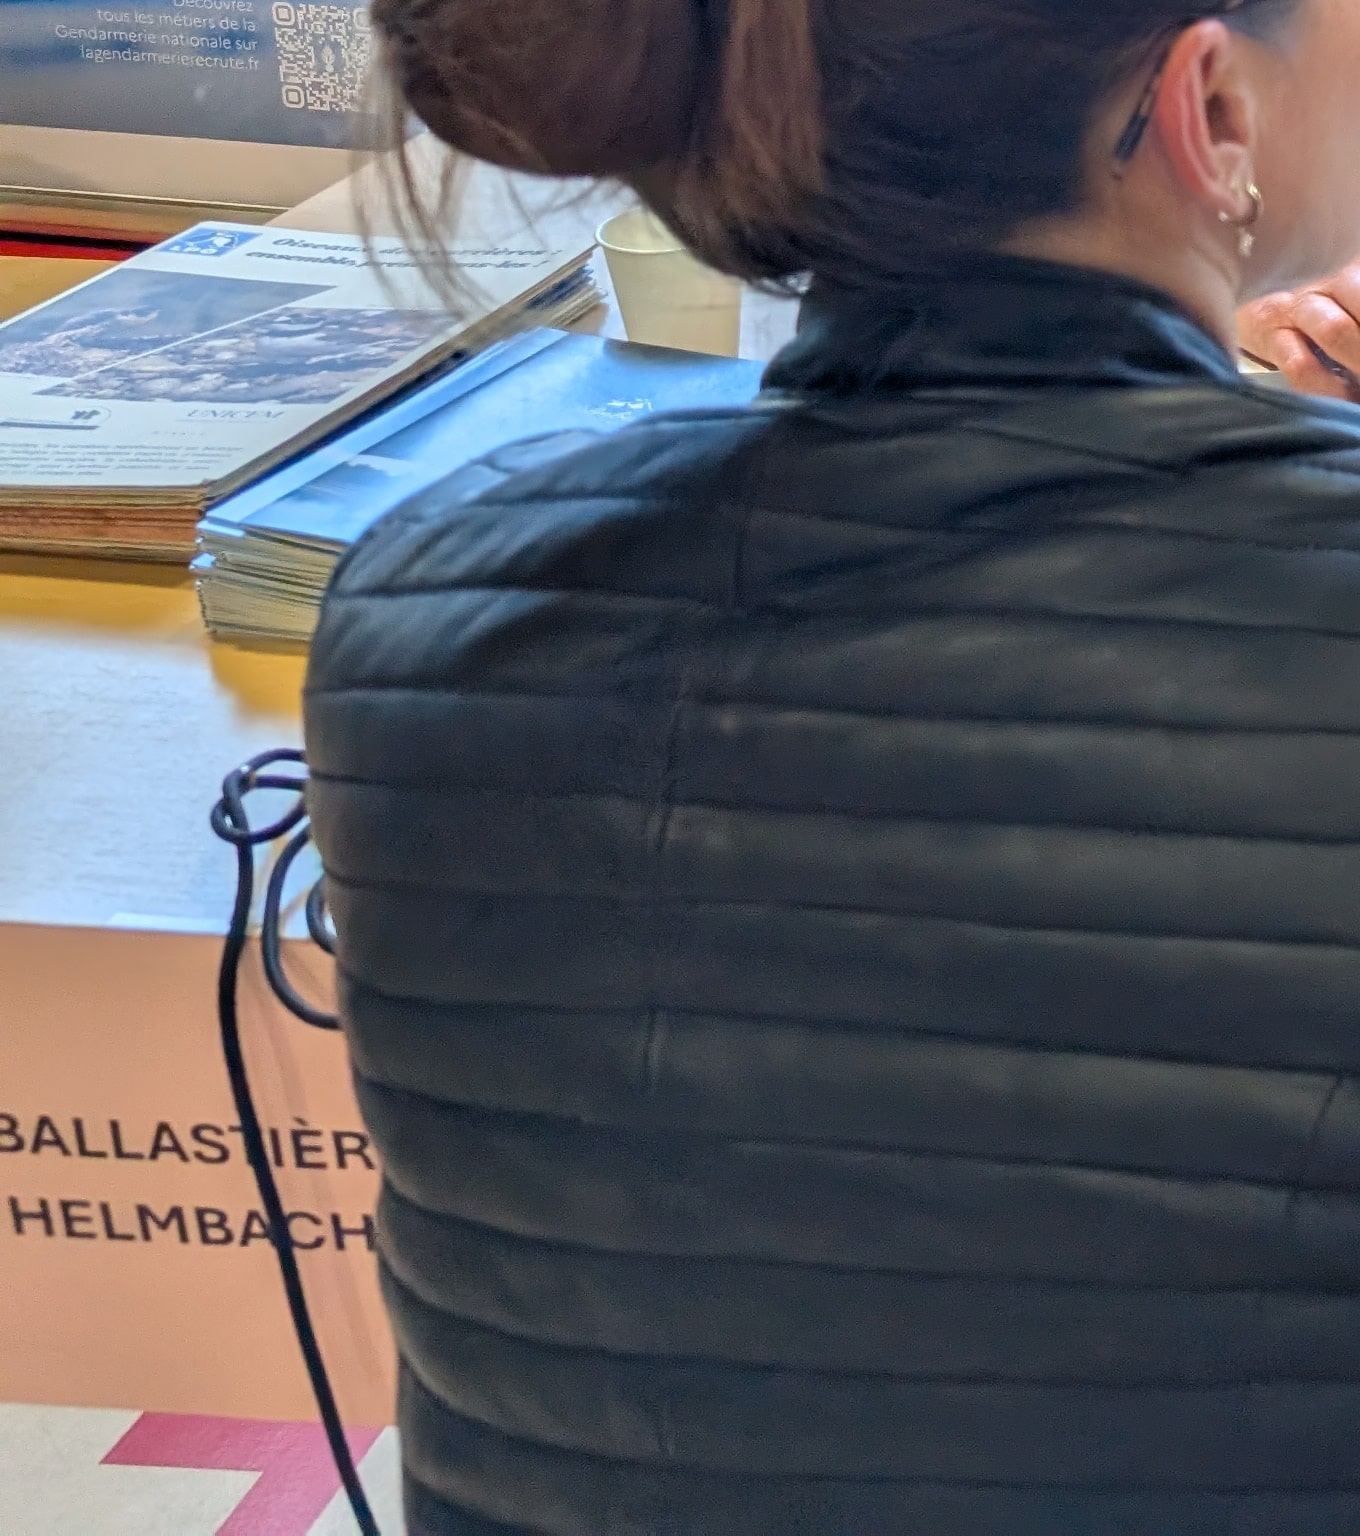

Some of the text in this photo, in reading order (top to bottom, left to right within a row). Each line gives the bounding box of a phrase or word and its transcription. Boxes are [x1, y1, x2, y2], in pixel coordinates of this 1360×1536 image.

[97, 8, 256, 32] tous les métiers de la
[55, 24, 257, 51] Gendarmerie nationale sur
[80, 45, 260, 70] lagendarmerierecrute.fr
